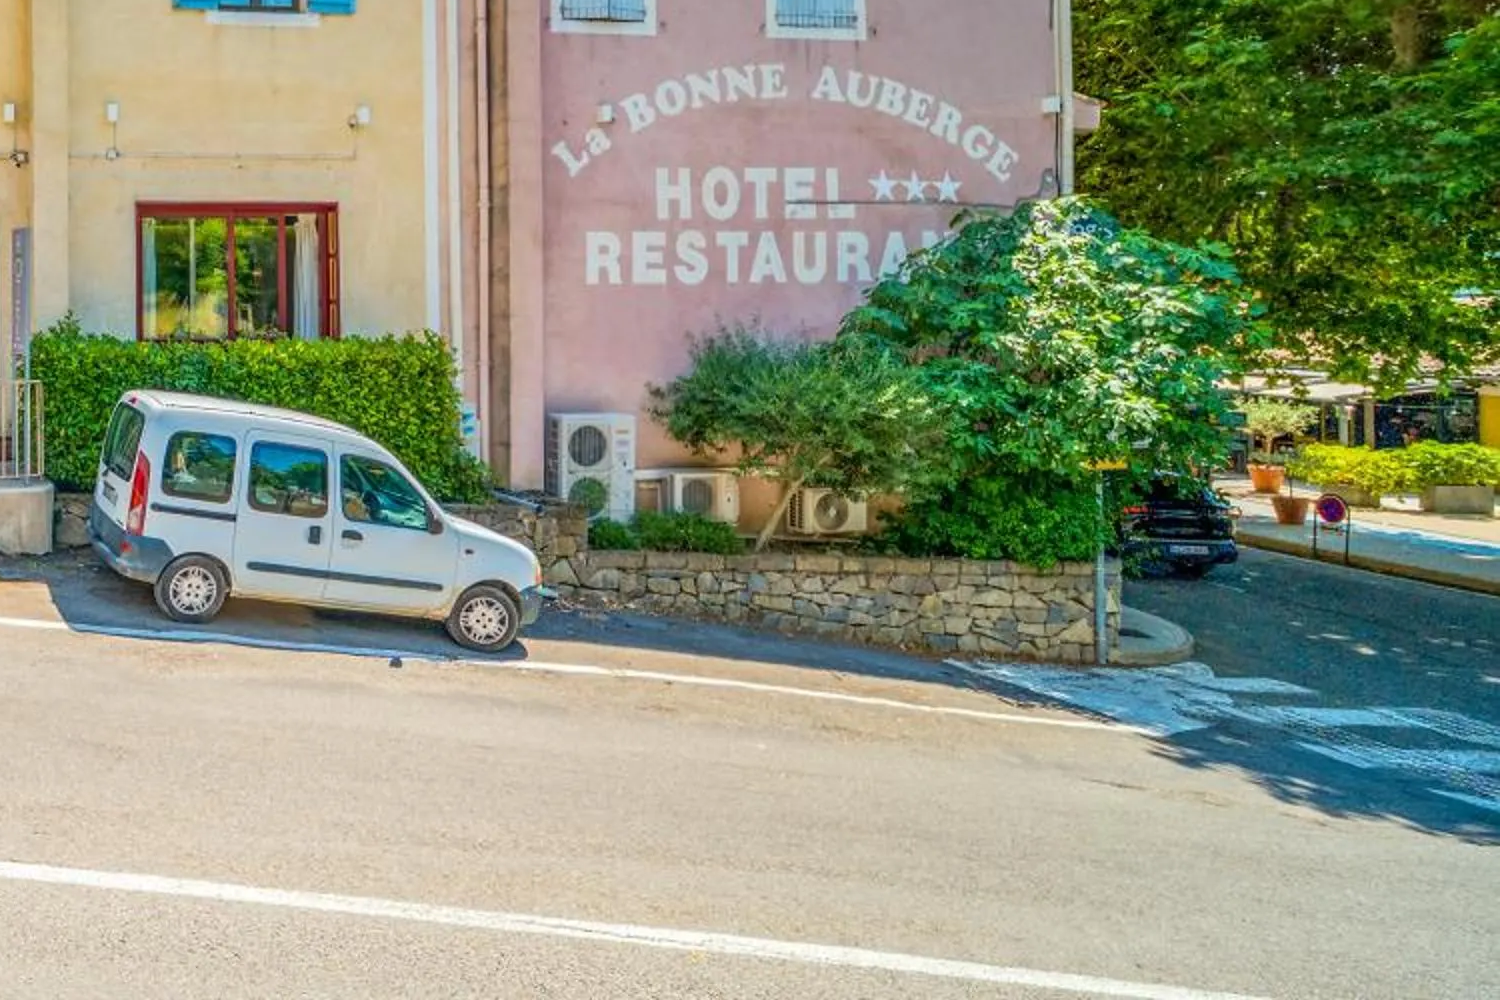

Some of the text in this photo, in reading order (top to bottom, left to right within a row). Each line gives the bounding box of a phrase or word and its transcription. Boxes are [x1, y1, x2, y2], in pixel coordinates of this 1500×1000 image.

[551, 63, 1020, 184] La BONNE AUBERGE
[655, 166, 857, 221] HOTEL
